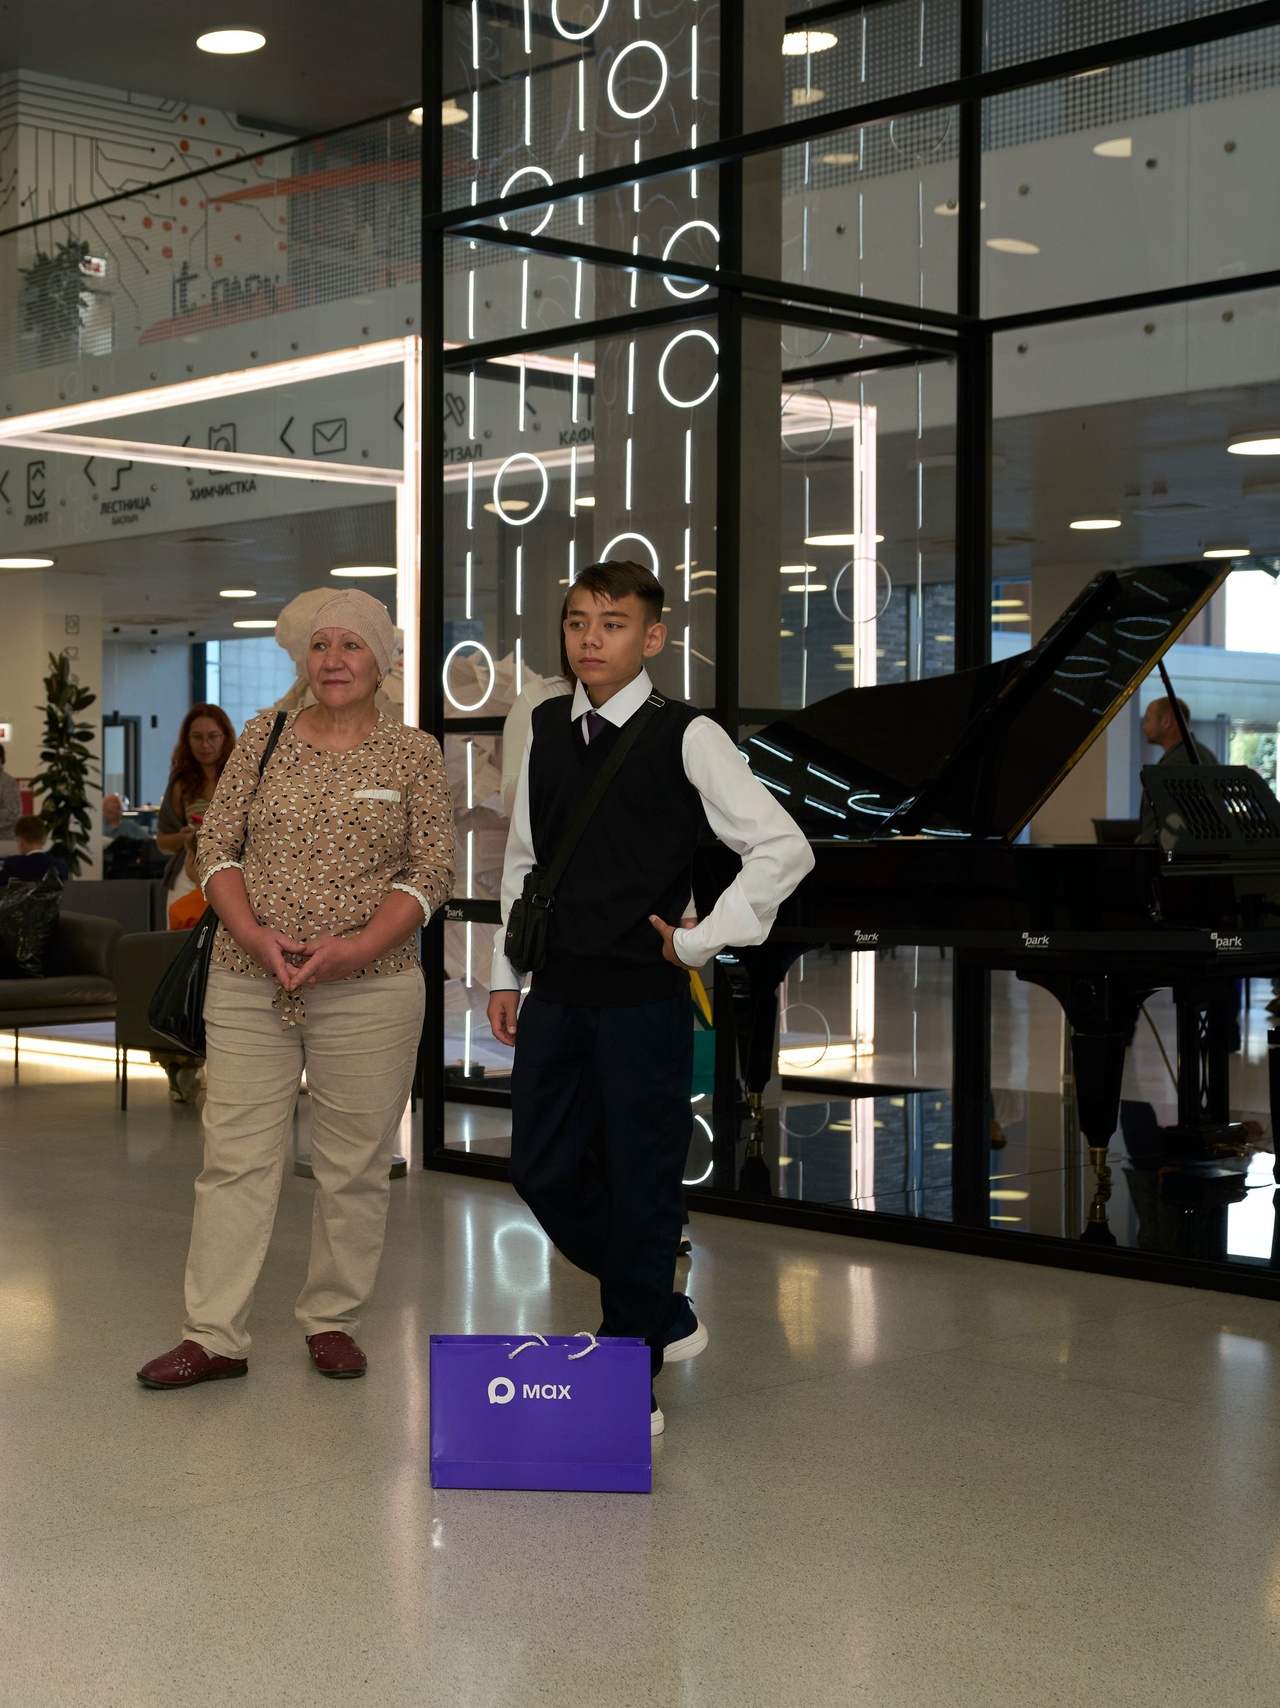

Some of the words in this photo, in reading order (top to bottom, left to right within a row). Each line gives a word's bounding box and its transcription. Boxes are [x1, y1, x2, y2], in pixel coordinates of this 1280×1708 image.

[189, 479, 257, 501] ХИМЧИСТКА
[100, 497, 151, 515] ЛЕСТНИЦА
[24, 511, 49, 527] ЛИФТ
[1025, 935, 1050, 947] park
[1215, 935, 1243, 949] park
